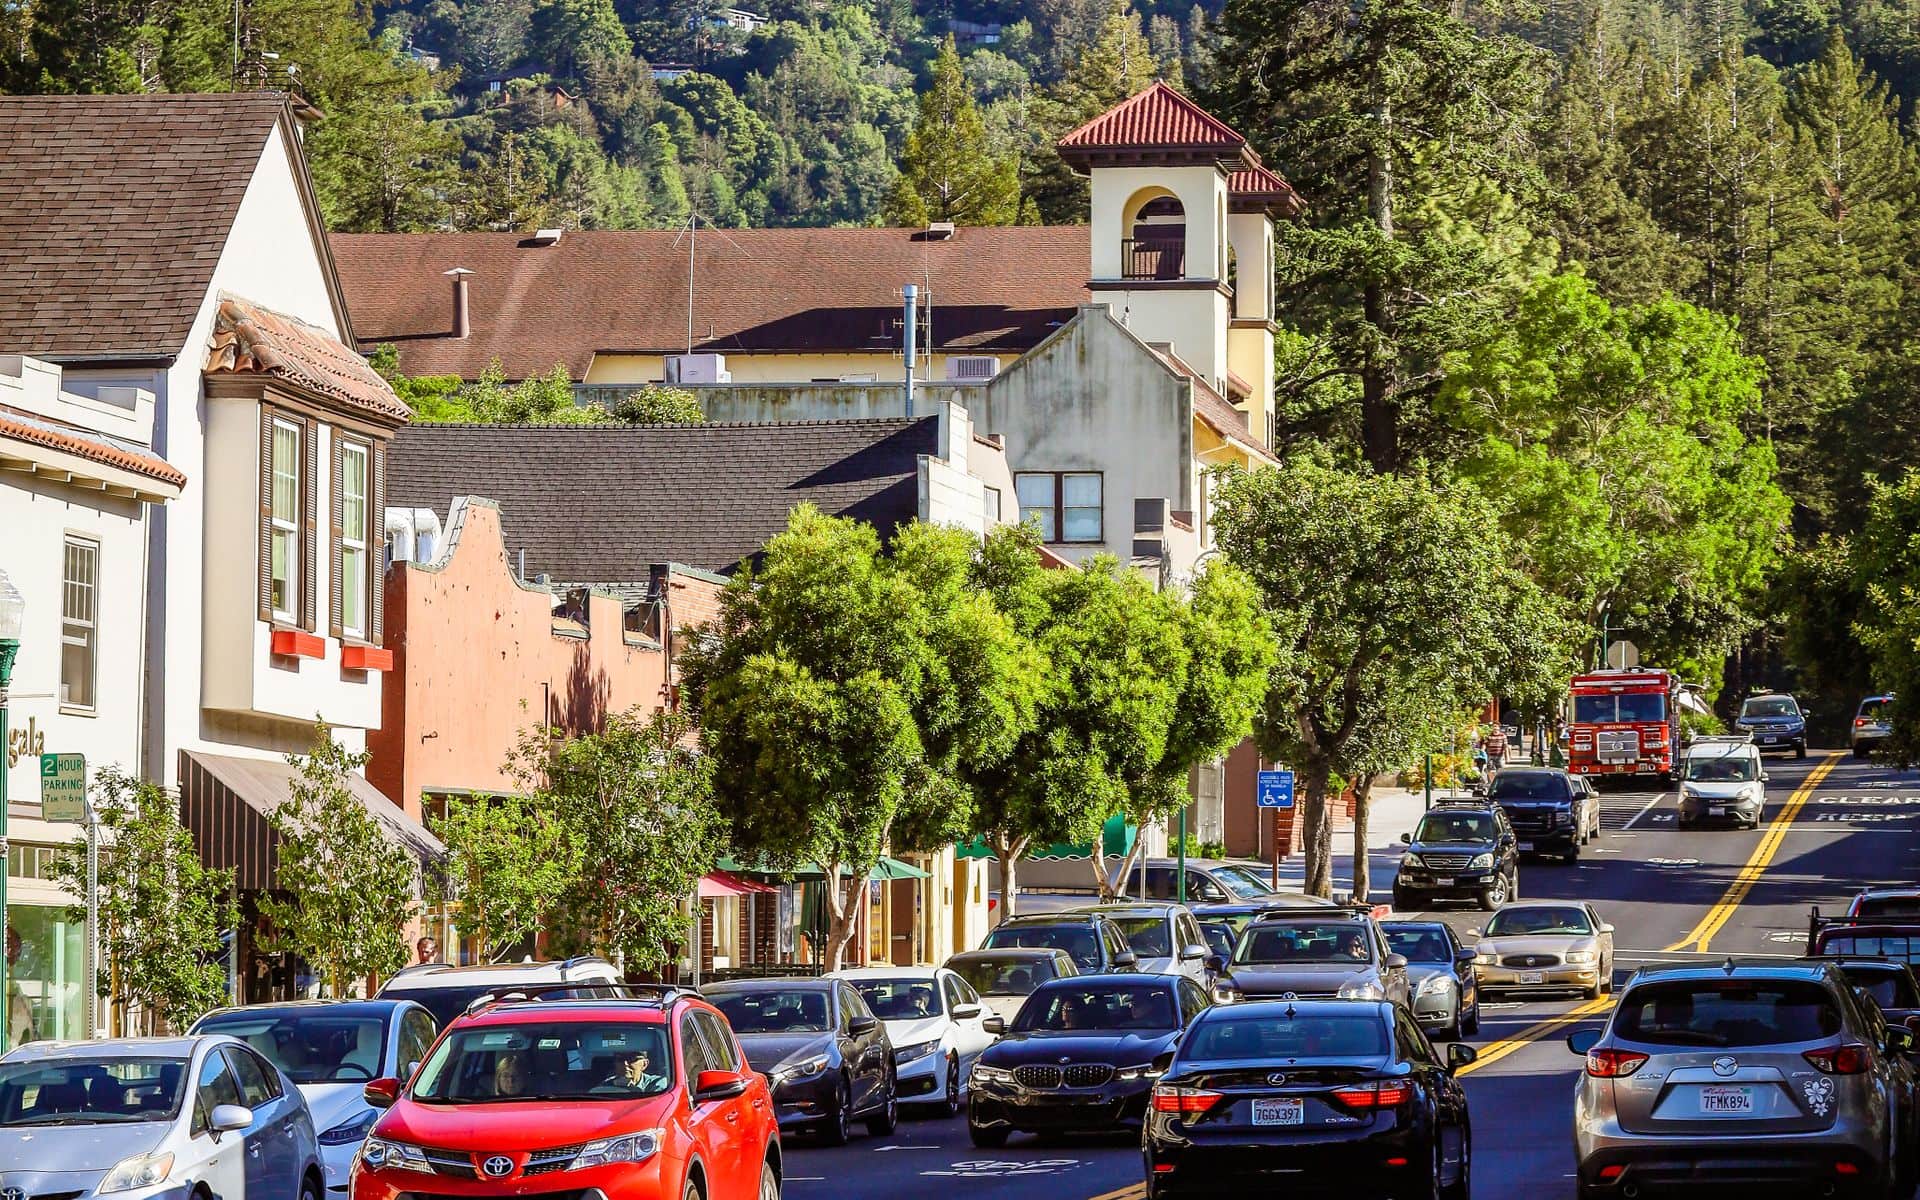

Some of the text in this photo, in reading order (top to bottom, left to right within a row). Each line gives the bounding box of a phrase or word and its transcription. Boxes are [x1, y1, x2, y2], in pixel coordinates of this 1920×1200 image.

[44, 759, 83, 773] 2 HOUR
[44, 780, 83, 790] PARKING
[1703, 1096, 1750, 1109] 7FMK894
[1255, 1108, 1300, 1121] 7GGX397
